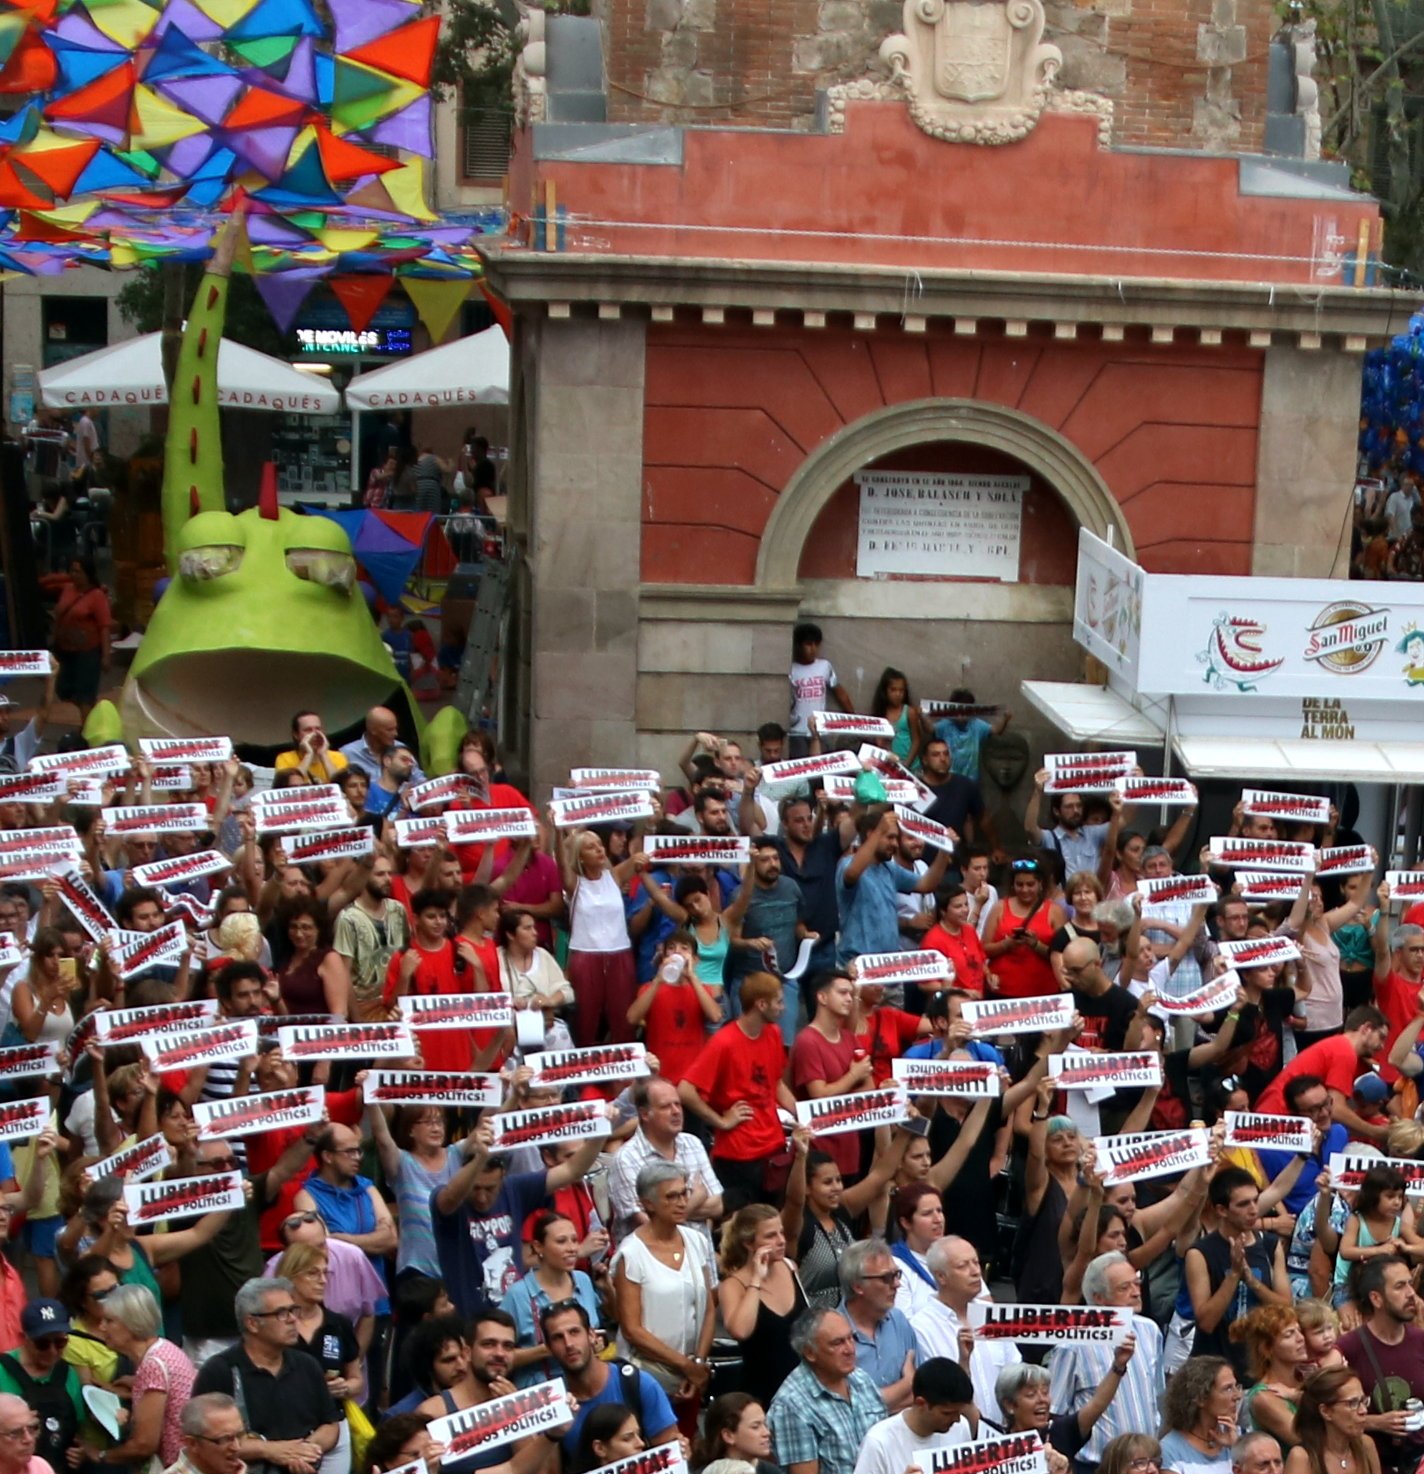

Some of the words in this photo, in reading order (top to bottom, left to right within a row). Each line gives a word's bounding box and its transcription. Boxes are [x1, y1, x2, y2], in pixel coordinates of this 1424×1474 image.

[65, 387, 163, 404] CADAQUÉ
[1304, 632, 1336, 655] San
[1338, 616, 1387, 643] Miguel
[1302, 697, 1320, 709] DE
[1324, 697, 1340, 709] LA
[1302, 710, 1348, 723] TERRA
[1301, 724, 1318, 739] AL
[984, 1305, 1111, 1327] LLIBERTAT
[445, 1388, 553, 1439] LLIBERTAT
[932, 1439, 1032, 1474] LLIBERTAT
